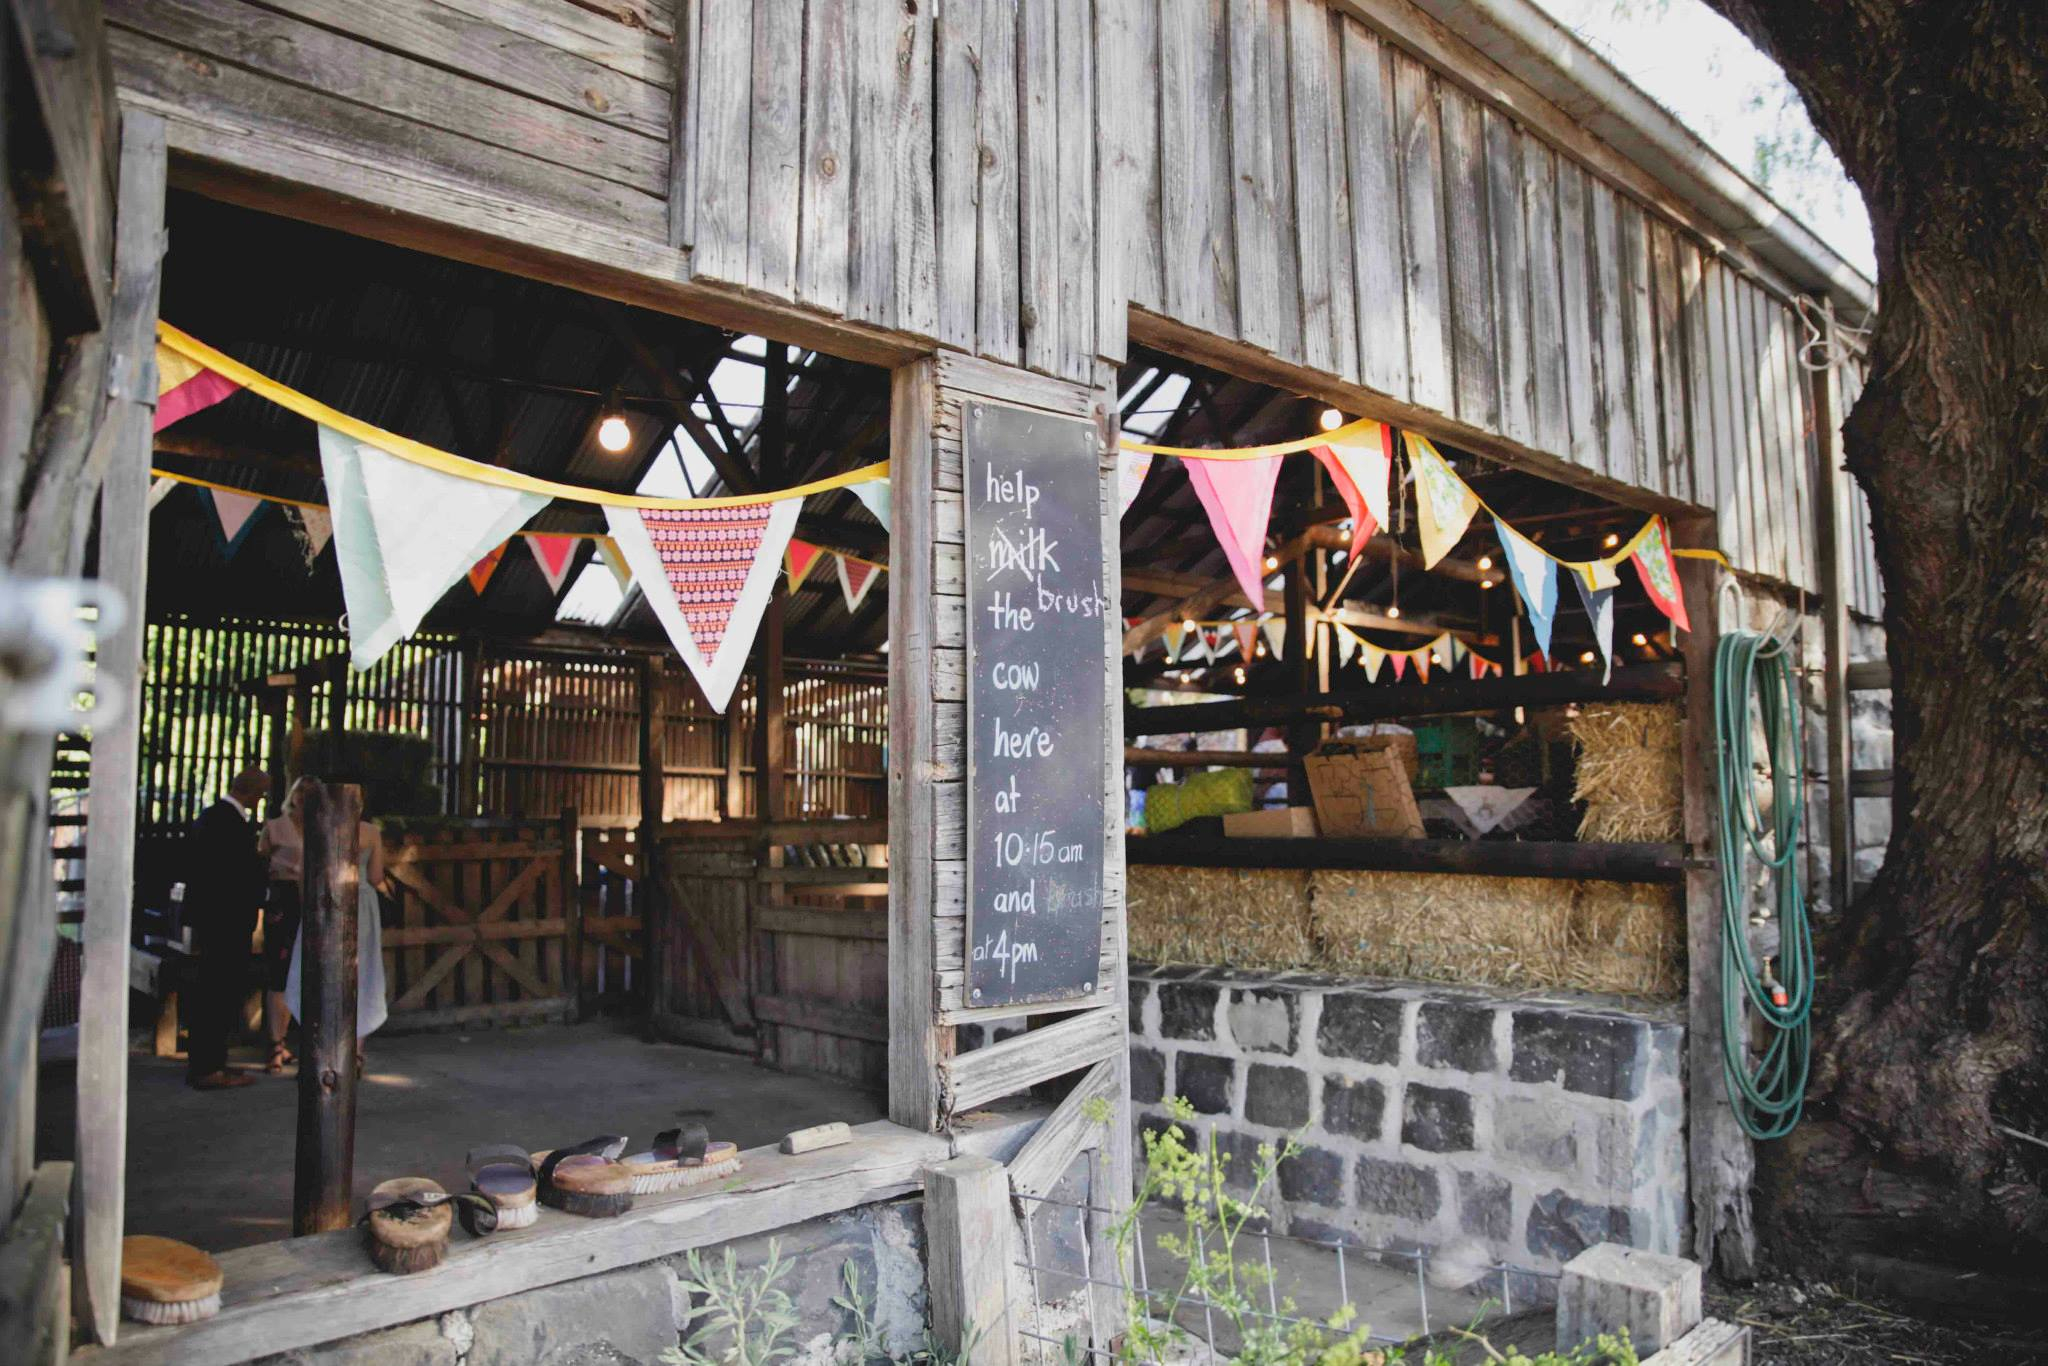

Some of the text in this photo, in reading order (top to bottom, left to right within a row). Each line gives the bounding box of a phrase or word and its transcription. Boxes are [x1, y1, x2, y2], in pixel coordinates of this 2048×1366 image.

[986, 461, 1040, 519] help
[987, 590, 1035, 631] the
[1037, 572, 1104, 618] brush
[992, 661, 1039, 690] cow
[993, 717, 1054, 758] here
[995, 774, 1021, 814] at
[1058, 842, 1083, 863] am
[994, 879, 1036, 914] and
[973, 929, 1038, 984] at 4pm
